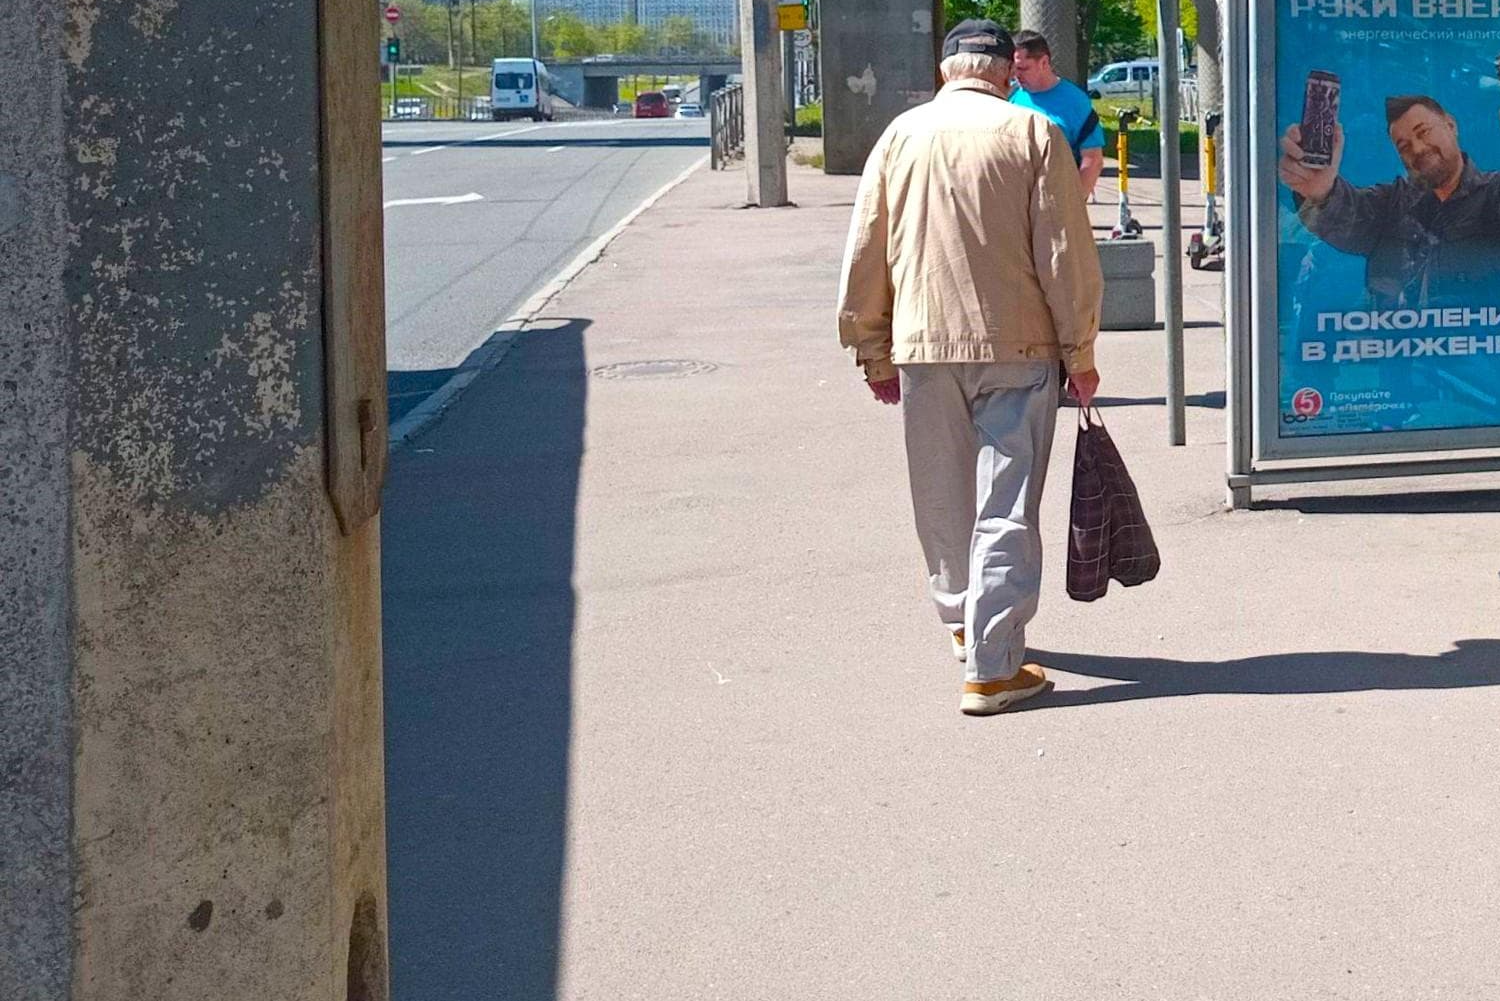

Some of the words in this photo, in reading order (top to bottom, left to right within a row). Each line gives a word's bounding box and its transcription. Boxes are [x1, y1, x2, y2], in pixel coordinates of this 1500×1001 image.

[1341, 28, 1454, 42] энергетический
[1302, 342, 1326, 362] В
[1329, 390, 1392, 402] Покупайте
